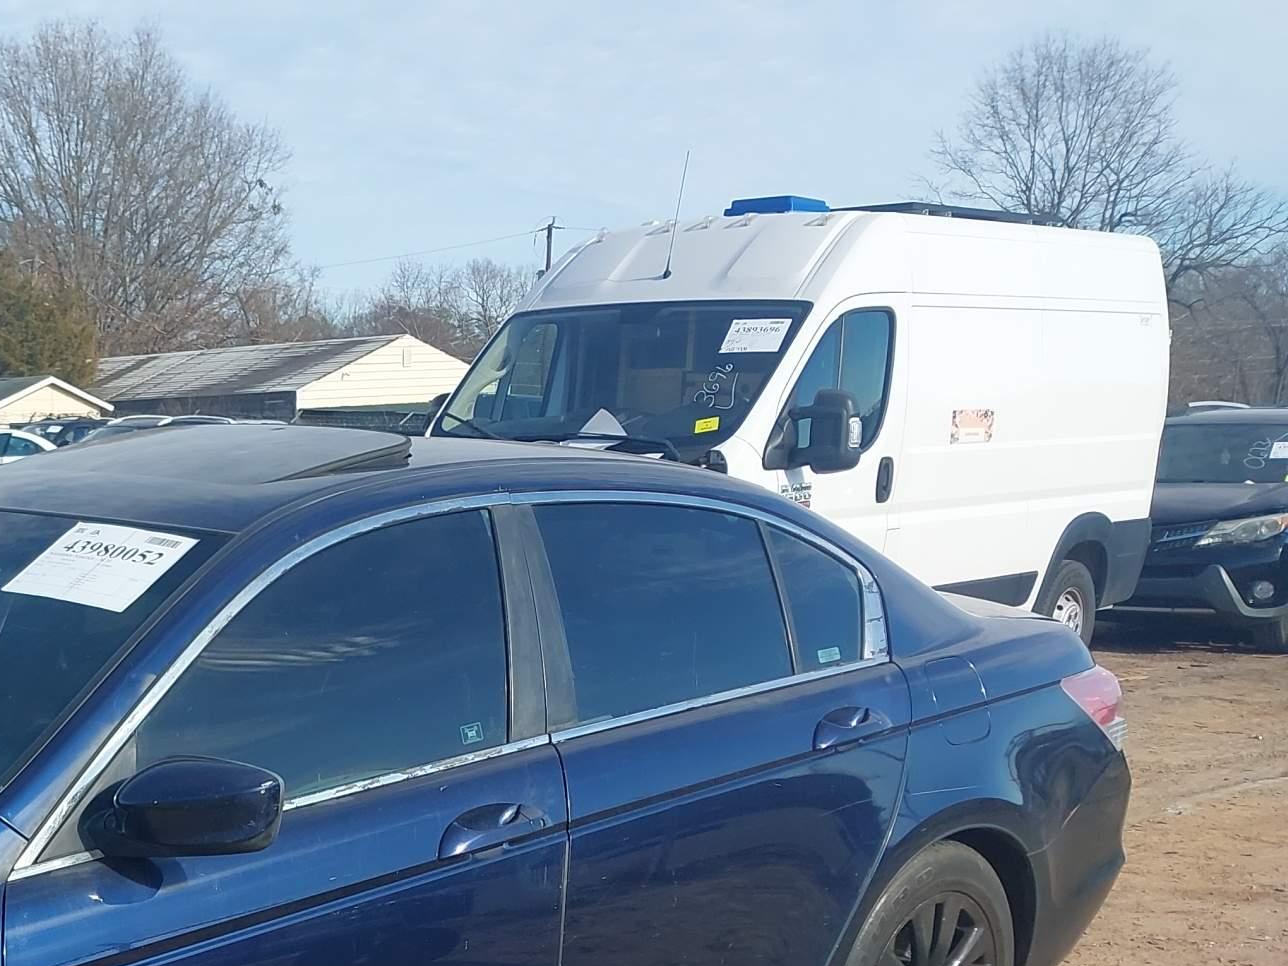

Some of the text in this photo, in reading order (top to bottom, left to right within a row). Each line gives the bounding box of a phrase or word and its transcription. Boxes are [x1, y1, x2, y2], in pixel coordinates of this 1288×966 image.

[734, 325, 782, 335] 43893696
[693, 363, 734, 408] 3696
[64, 539, 166, 566] 43980052
